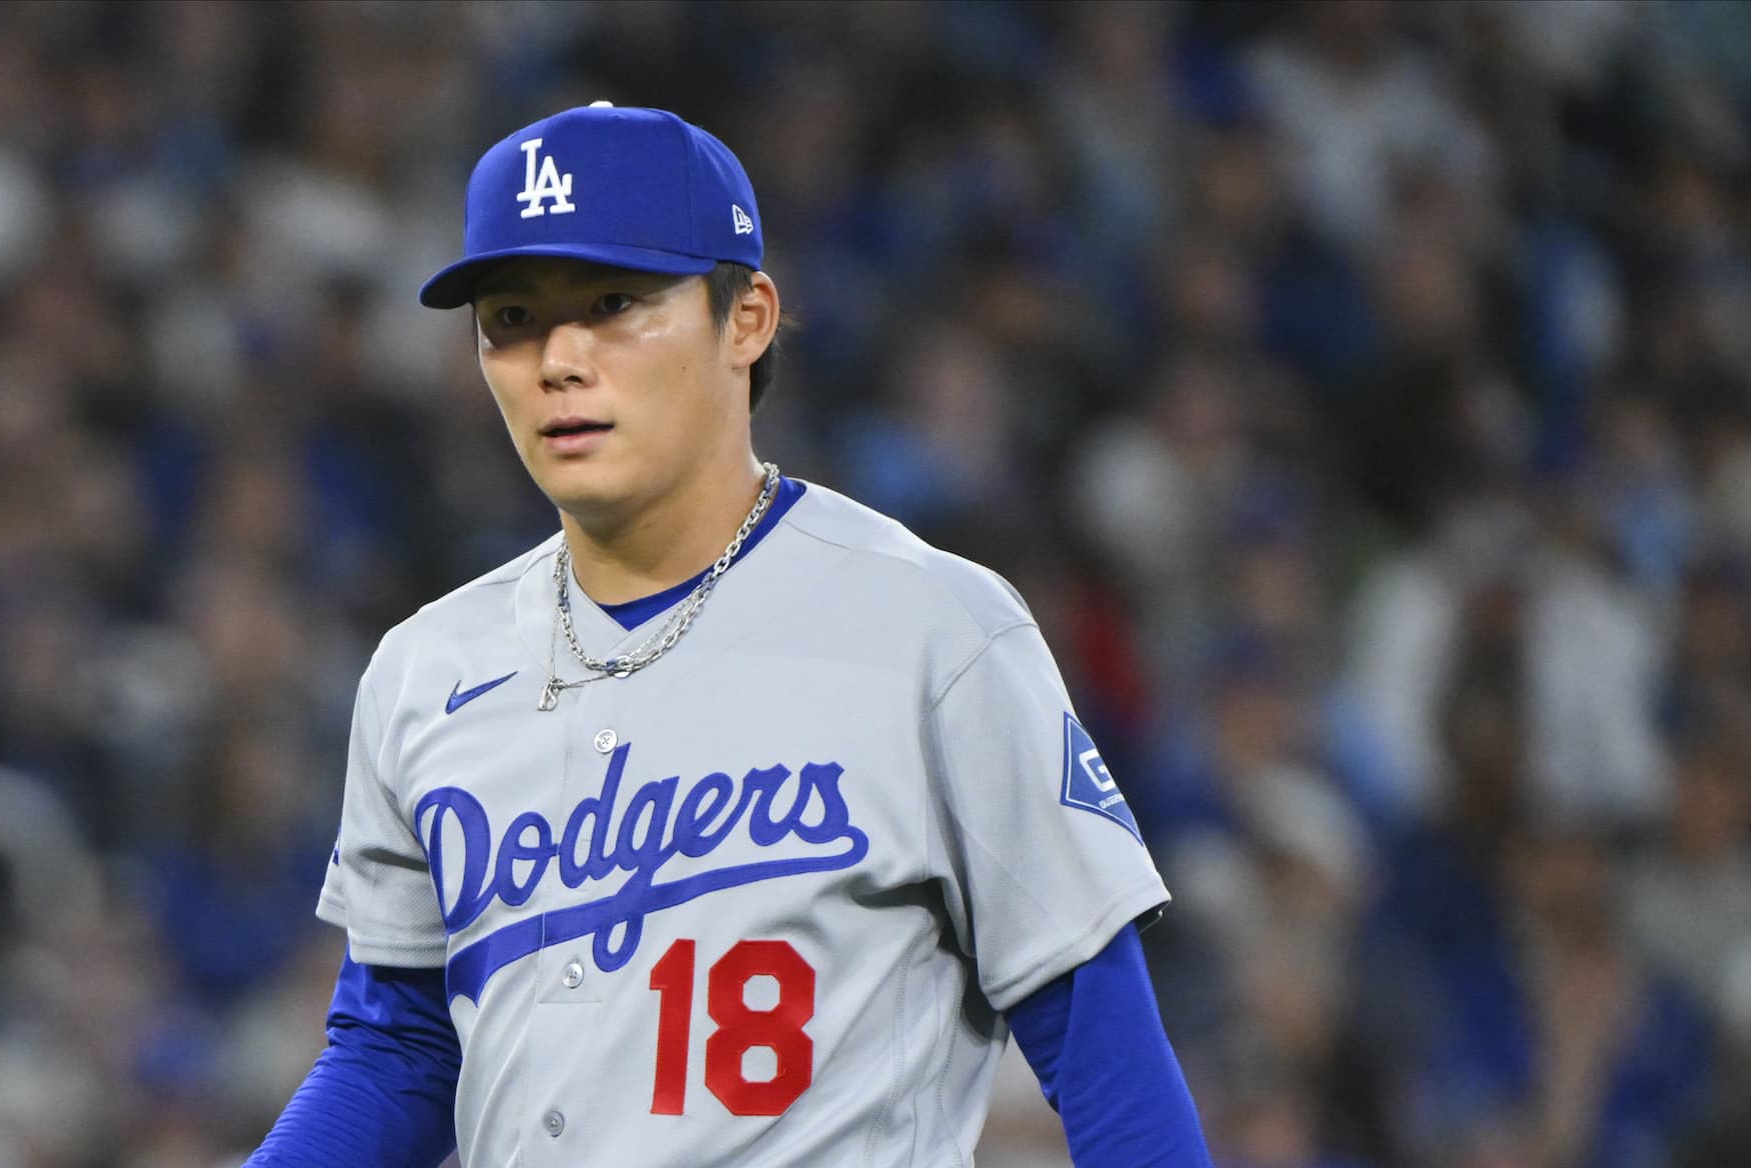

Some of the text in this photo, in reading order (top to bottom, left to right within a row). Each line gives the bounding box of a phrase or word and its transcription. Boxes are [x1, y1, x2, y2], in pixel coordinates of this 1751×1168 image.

[516, 137, 576, 219] LA
[415, 742, 870, 973] Dodgers
[649, 938, 816, 1117] 18
